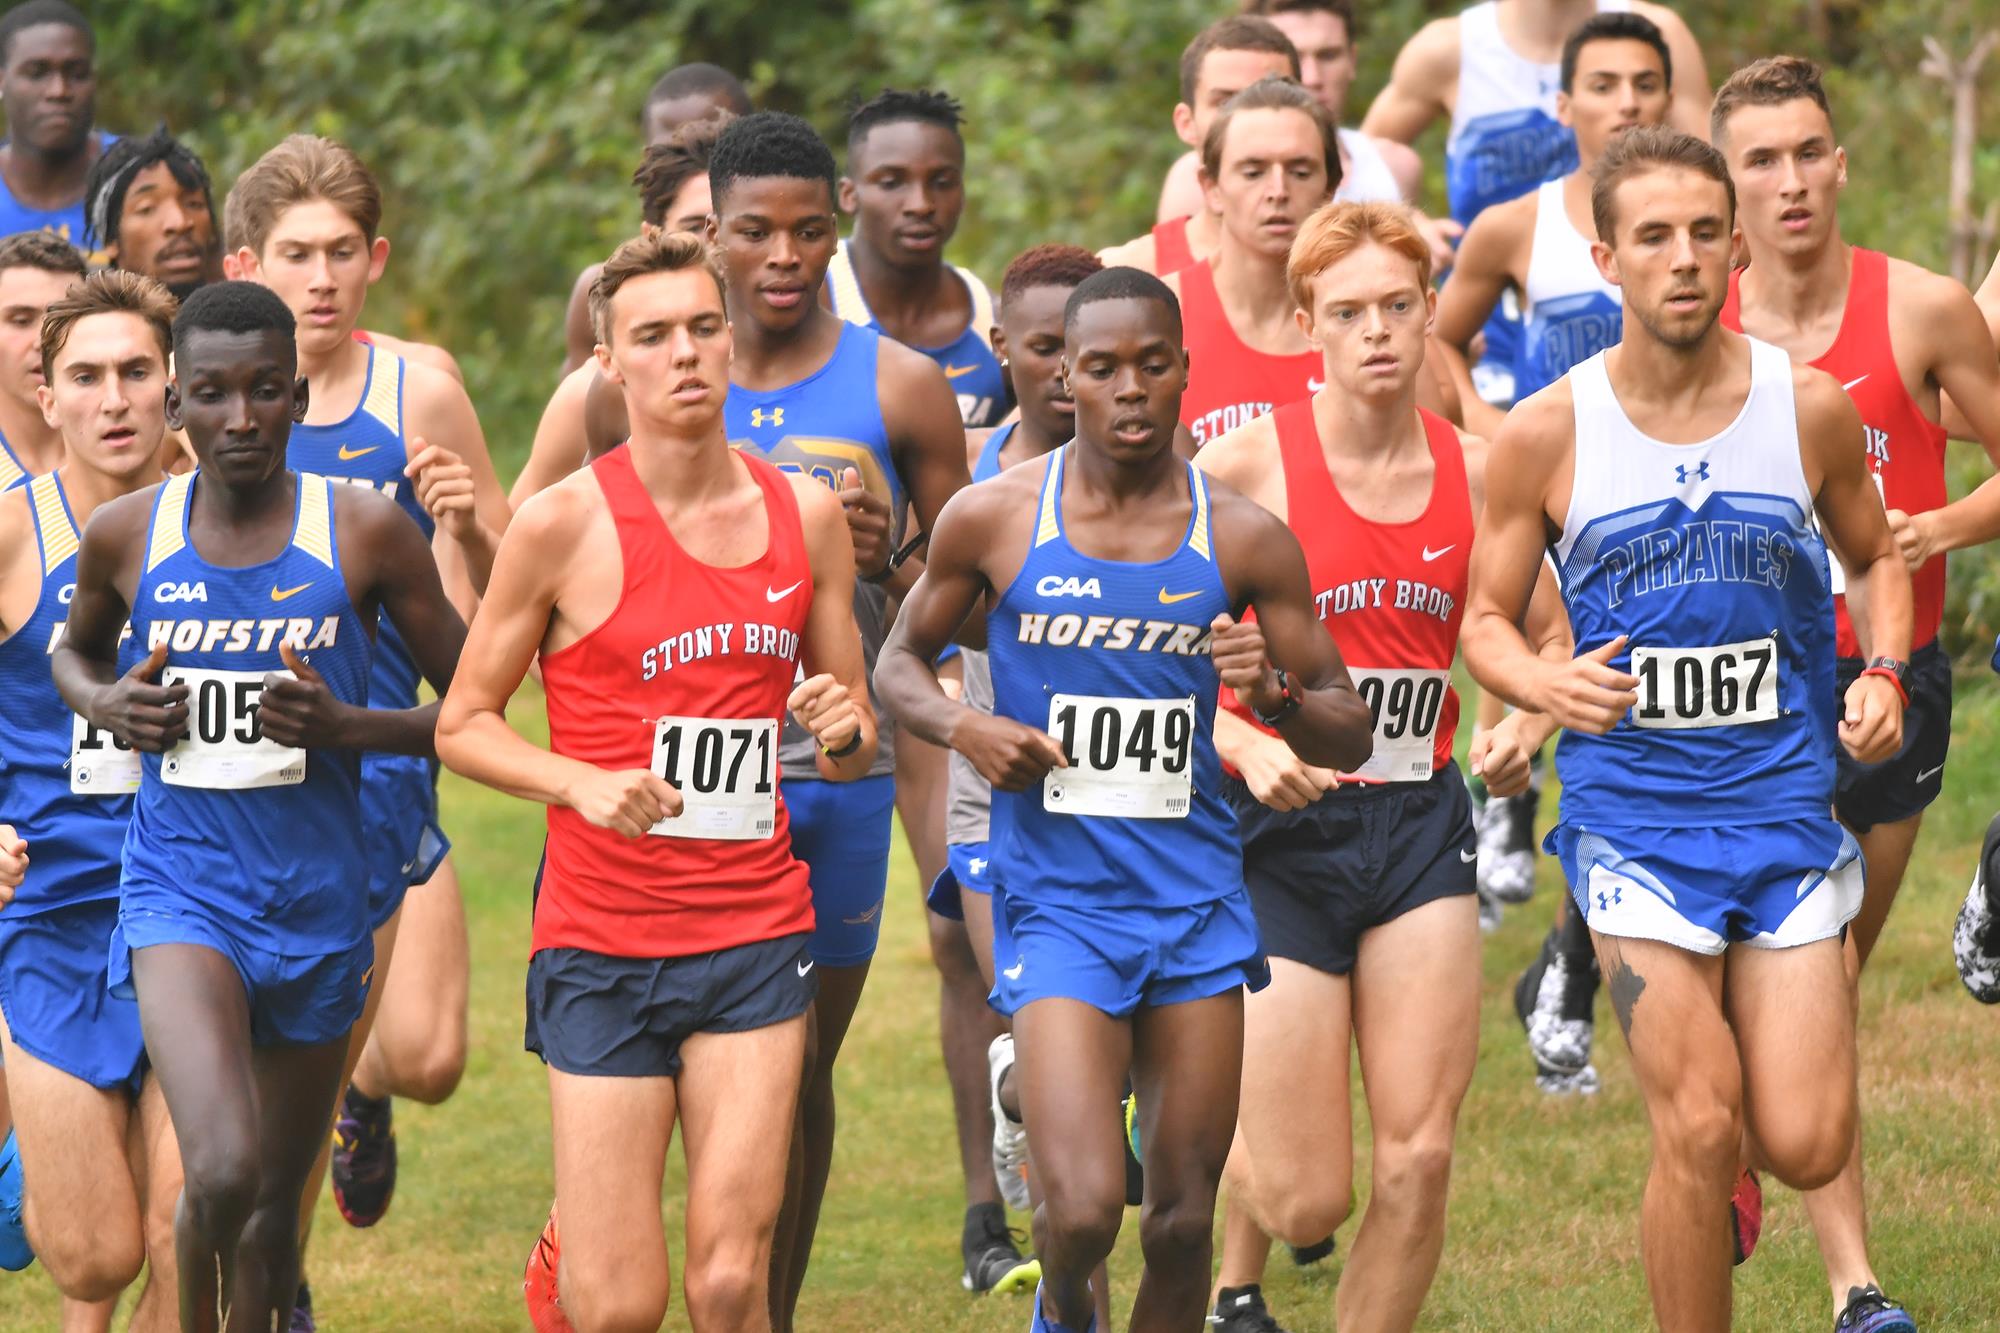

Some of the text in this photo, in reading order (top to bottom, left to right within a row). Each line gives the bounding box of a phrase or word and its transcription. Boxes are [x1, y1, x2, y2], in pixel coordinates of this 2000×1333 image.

[154, 582, 208, 603] CAA
[1036, 575, 1102, 598] CAA
[1600, 520, 1794, 609] PIRATES
[1315, 578, 1454, 622] TONY BROO
[147, 616, 339, 652] HOFSTRA
[641, 621, 799, 681] STONY BROO
[1357, 677, 1443, 739] 090
[1639, 648, 1772, 719] 1067
[661, 725, 772, 794] 1071
[1057, 705, 1191, 773] 1049
